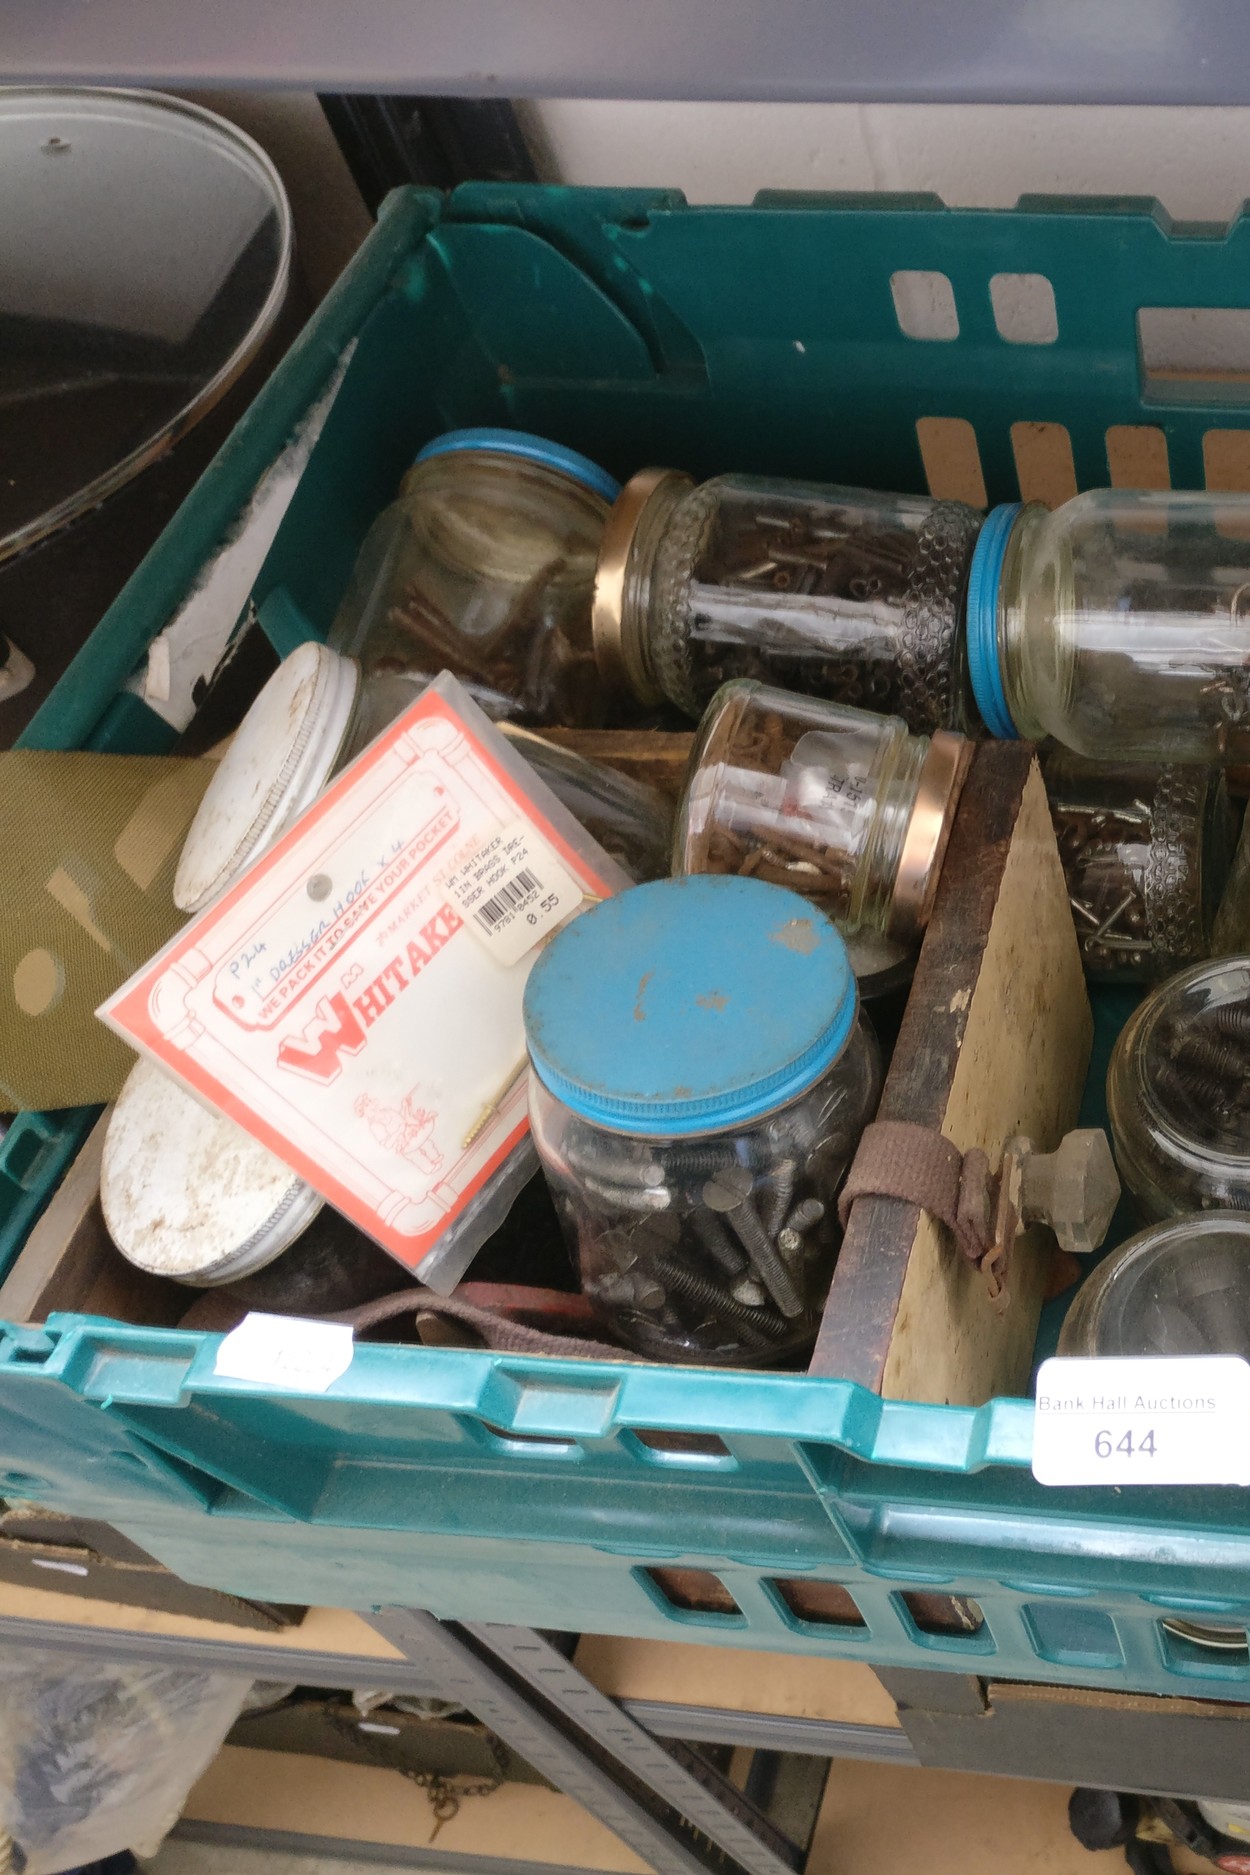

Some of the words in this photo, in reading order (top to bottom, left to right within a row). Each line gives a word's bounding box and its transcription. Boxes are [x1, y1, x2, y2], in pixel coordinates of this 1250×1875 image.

[460, 836, 503, 876] WHITAKER
[473, 854, 501, 882] BRASS
[462, 886, 485, 909] SSER
[486, 864, 509, 887] HOOK
[510, 847, 528, 865] P24
[258, 996, 281, 1020] WE
[281, 960, 315, 998] PACK
[314, 946, 327, 962] IT
[326, 928, 344, 949] TO
[344, 893, 377, 928] SAVE
[375, 859, 410, 893] YOUR
[409, 811, 453, 859] POCKET
[388, 885, 432, 931] MARKET
[526, 892, 559, 926] 0.55
[277, 902, 464, 1087] WHITAKE
[1039, 1396, 1085, 1411] Bank
[1093, 1396, 1127, 1410] Hall
[1134, 1395, 1217, 1410] Auctions
[1094, 1429, 1158, 1459] 644
